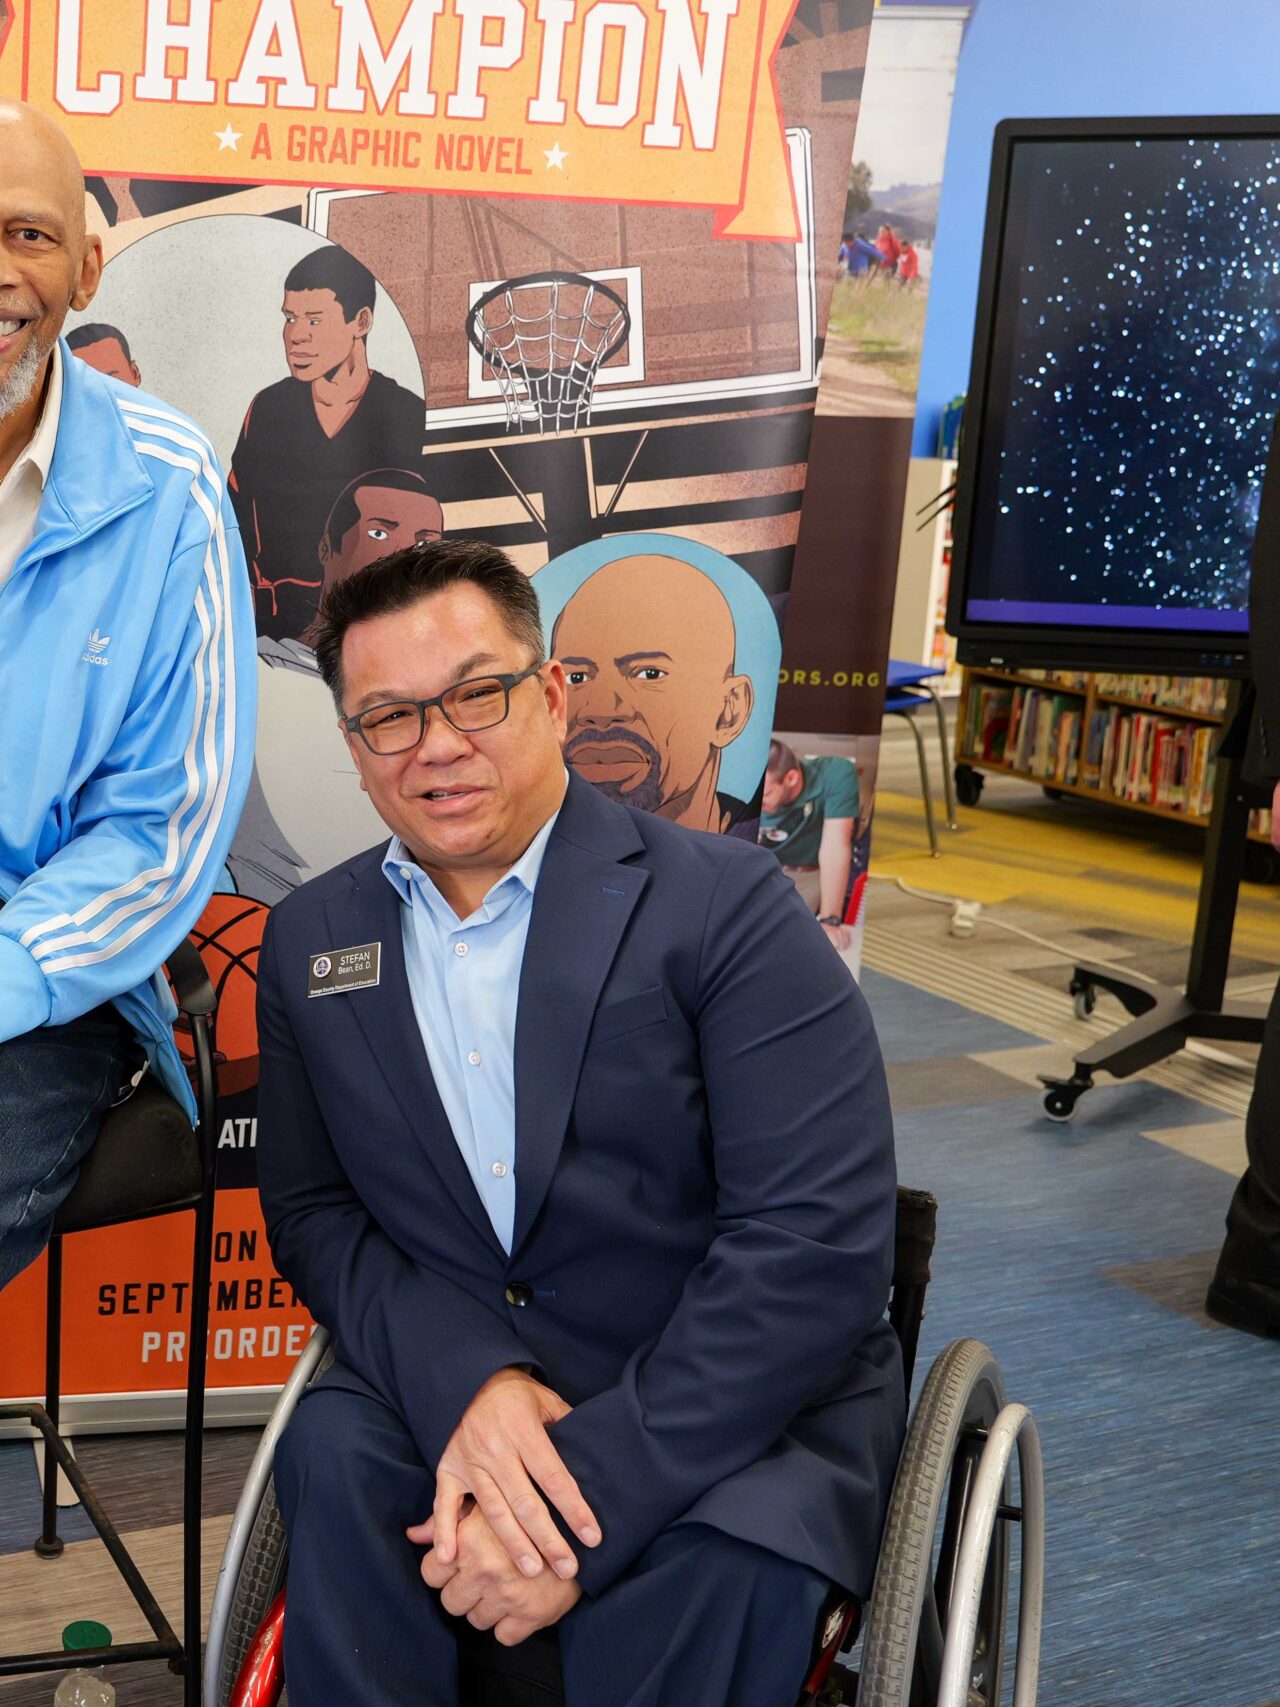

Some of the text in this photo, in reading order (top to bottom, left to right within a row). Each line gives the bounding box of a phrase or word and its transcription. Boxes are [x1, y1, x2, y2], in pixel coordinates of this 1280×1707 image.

[53, 0, 740, 151] CHAMPION
[250, 122, 533, 175] A GRAPHIC NOVEL
[340, 952, 370, 966] STEFAN
[214, 1230, 257, 1263] ON
[98, 1277, 307, 1316] SEPTMBE
[141, 1324, 318, 1364] PRORDE
